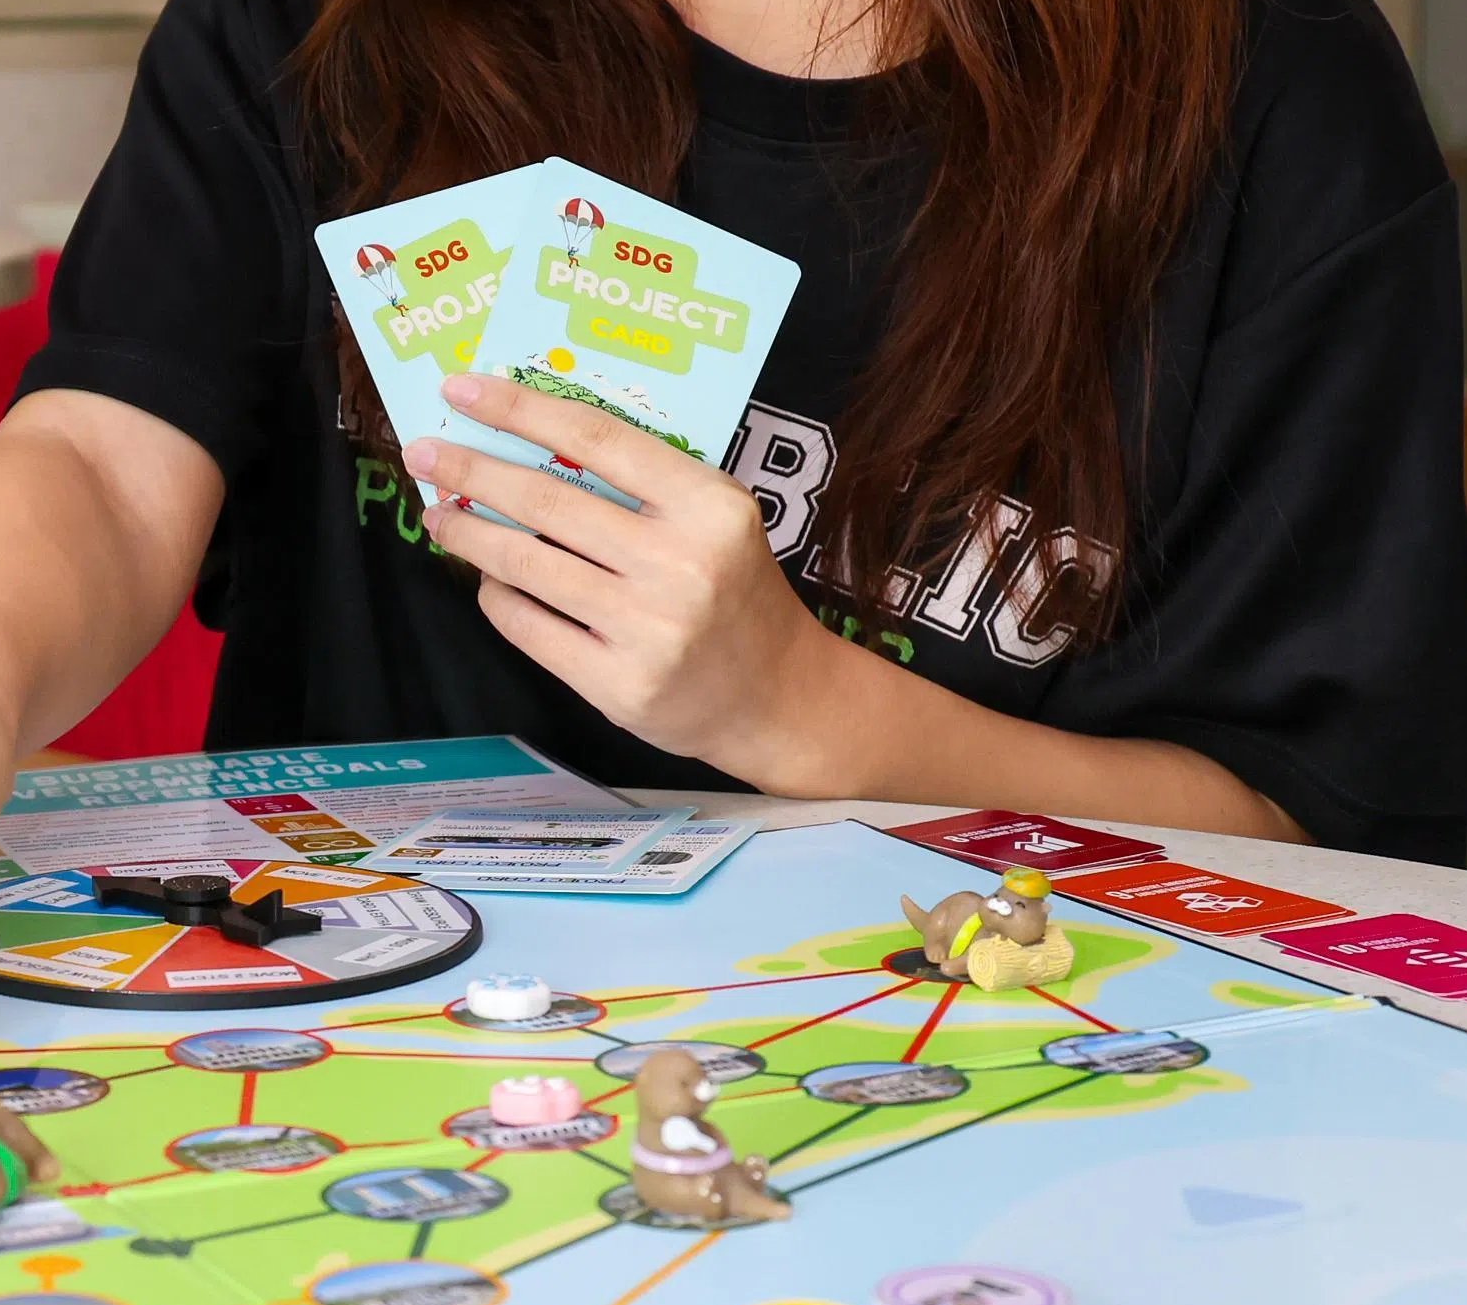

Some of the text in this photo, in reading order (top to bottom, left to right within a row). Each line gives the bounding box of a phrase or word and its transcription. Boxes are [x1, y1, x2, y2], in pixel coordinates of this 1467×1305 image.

[415, 241, 469, 277] SDG
[614, 241, 673, 273] SDG
[389, 270, 500, 345] PROJE
[549, 260, 737, 336] PROJECT
[590, 318, 671, 355] CARD
[538, 462, 595, 492] RIPPLE EFFECT
[12, 757, 428, 801] VELOPMENT GOALS
[31, 751, 328, 789] SUSTAINABLE
[82, 776, 332, 807] REFERENCE
[943, 835, 969, 844] 8
[112, 867, 157, 875] DRAW
[1106, 890, 1133, 900] 9
[1327, 940, 1368, 956] 10
